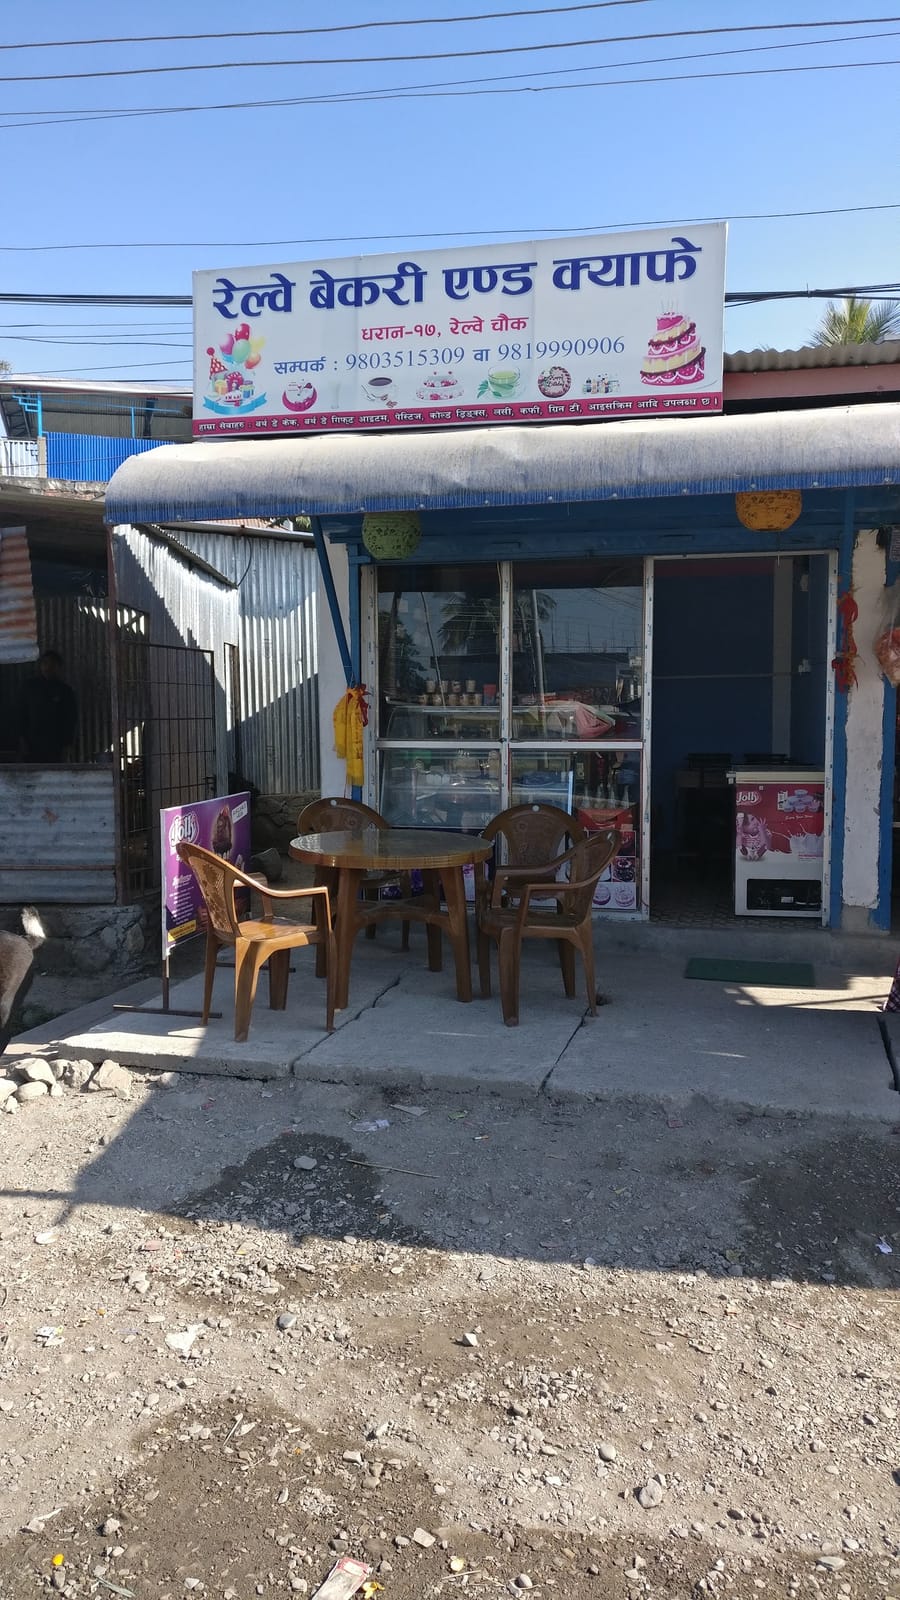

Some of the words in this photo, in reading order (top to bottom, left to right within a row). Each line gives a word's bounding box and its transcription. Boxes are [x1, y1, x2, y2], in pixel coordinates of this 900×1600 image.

[212, 273, 296, 319] रेल्वे
[309, 261, 427, 310] बेकरी
[442, 262, 537, 300] एण्ड
[552, 237, 702, 290] क्याफे
[361, 323, 441, 341] धरान-१७,
[449, 316, 484, 335] रेल्वे
[490, 313, 529, 332] चौक
[273, 356, 327, 375] सम्पर्क
[345, 346, 465, 371] 9803515309
[472, 349, 491, 362] वा
[497, 335, 625, 361] 9819990906
[637, 398, 658, 408] आदि
[170, 813, 198, 844] Jolly
